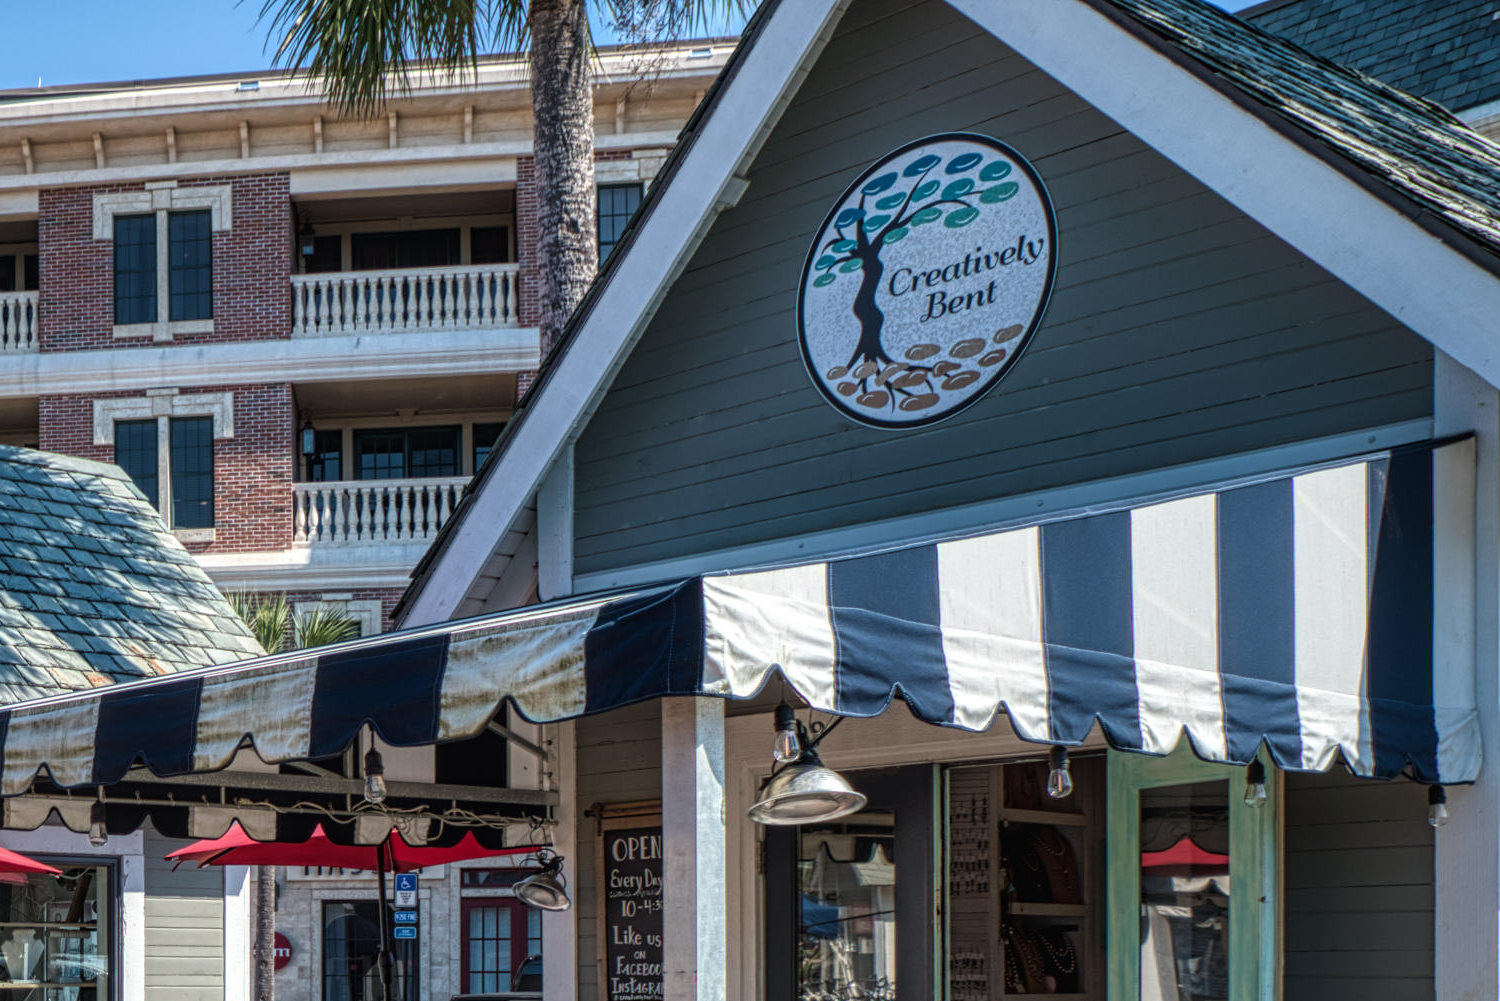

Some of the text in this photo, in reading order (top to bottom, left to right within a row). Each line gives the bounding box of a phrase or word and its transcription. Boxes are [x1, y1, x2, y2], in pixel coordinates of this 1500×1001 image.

[888, 235, 1045, 297] Creatively
[919, 280, 998, 323] Bent
[612, 834, 662, 862] OPEN
[610, 868, 643, 896] Every
[612, 925, 661, 948] Like us
[615, 955, 662, 976] FACEBOO
